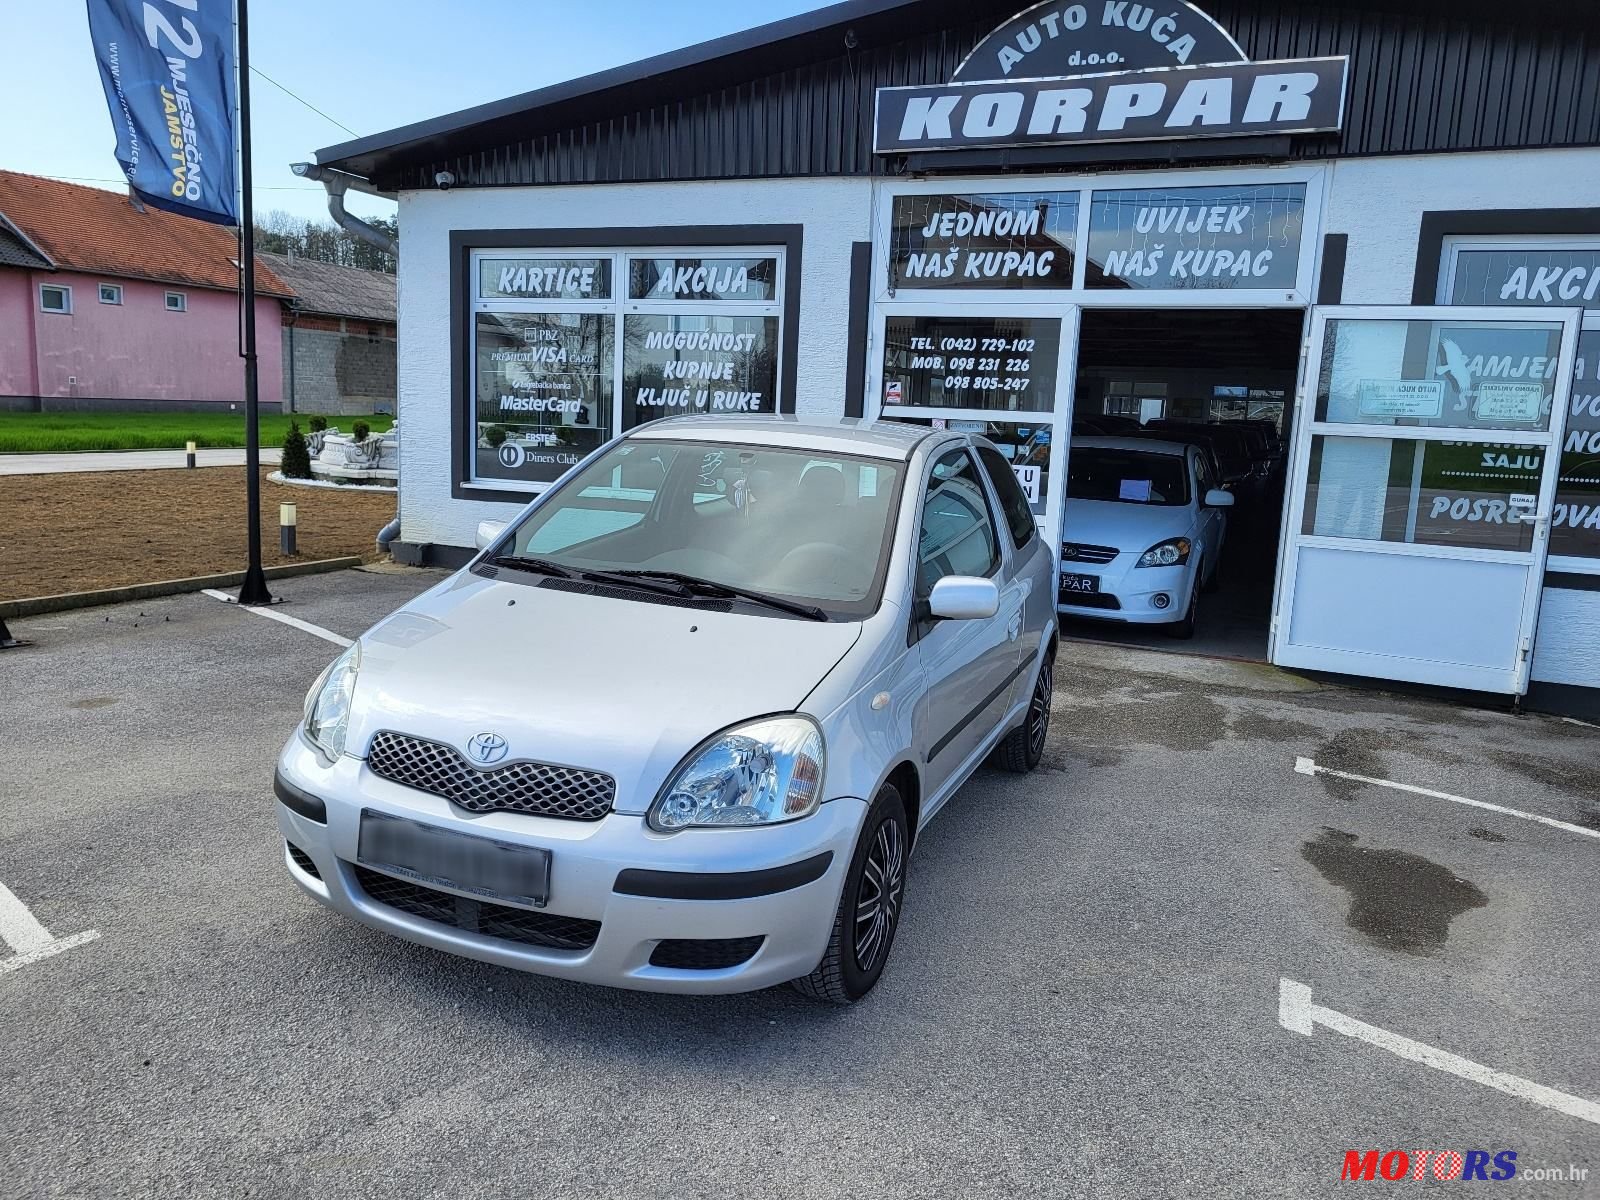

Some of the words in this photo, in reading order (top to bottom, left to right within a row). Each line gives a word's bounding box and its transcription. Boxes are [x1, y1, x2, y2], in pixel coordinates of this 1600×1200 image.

[997, 4, 1088, 75] AUTO
[1101, 0, 1198, 65] KUĆA
[1068, 50, 1125, 66] d.o.o.
[899, 72, 1319, 141] KORPAR
[160, 85, 185, 197] JAMSTVO
[166, 56, 203, 201] MJESEČNO
[922, 210, 1041, 239] JEDNOM
[1135, 205, 1251, 235] UVIJEK
[905, 246, 959, 278] NAŠ
[964, 250, 1054, 278] KUPAC
[1103, 243, 1165, 277] NAŠ
[1169, 249, 1273, 278] KUPAC
[498, 267, 595, 294] KARTICE
[657, 267, 749, 294] AKCIJA
[539, 329, 559, 341] PBZ
[645, 327, 756, 352] MOGUĆNOST
[910, 338, 935, 350] TEL.
[940, 338, 977, 351] (042)
[981, 339, 1036, 352] 729-102
[491, 352, 531, 362] PREMIUM
[531, 346, 567, 363] VISA
[569, 354, 594, 363] CARD
[911, 356, 945, 369] MOB.
[949, 357, 976, 371] 098
[978, 358, 1001, 371] 231
[1005, 358, 1031, 372] 226
[663, 361, 735, 381] KUPNJE
[944, 376, 971, 389] 098
[972, 377, 1030, 391] 805-247
[500, 395, 583, 413] MasterCard
[636, 385, 691, 408] KLJUČ
[695, 392, 710, 409] U
[713, 391, 762, 412] RUKE
[526, 433, 549, 442] ERSTE
[526, 451, 555, 464] Diners
[556, 453, 577, 465] Club
